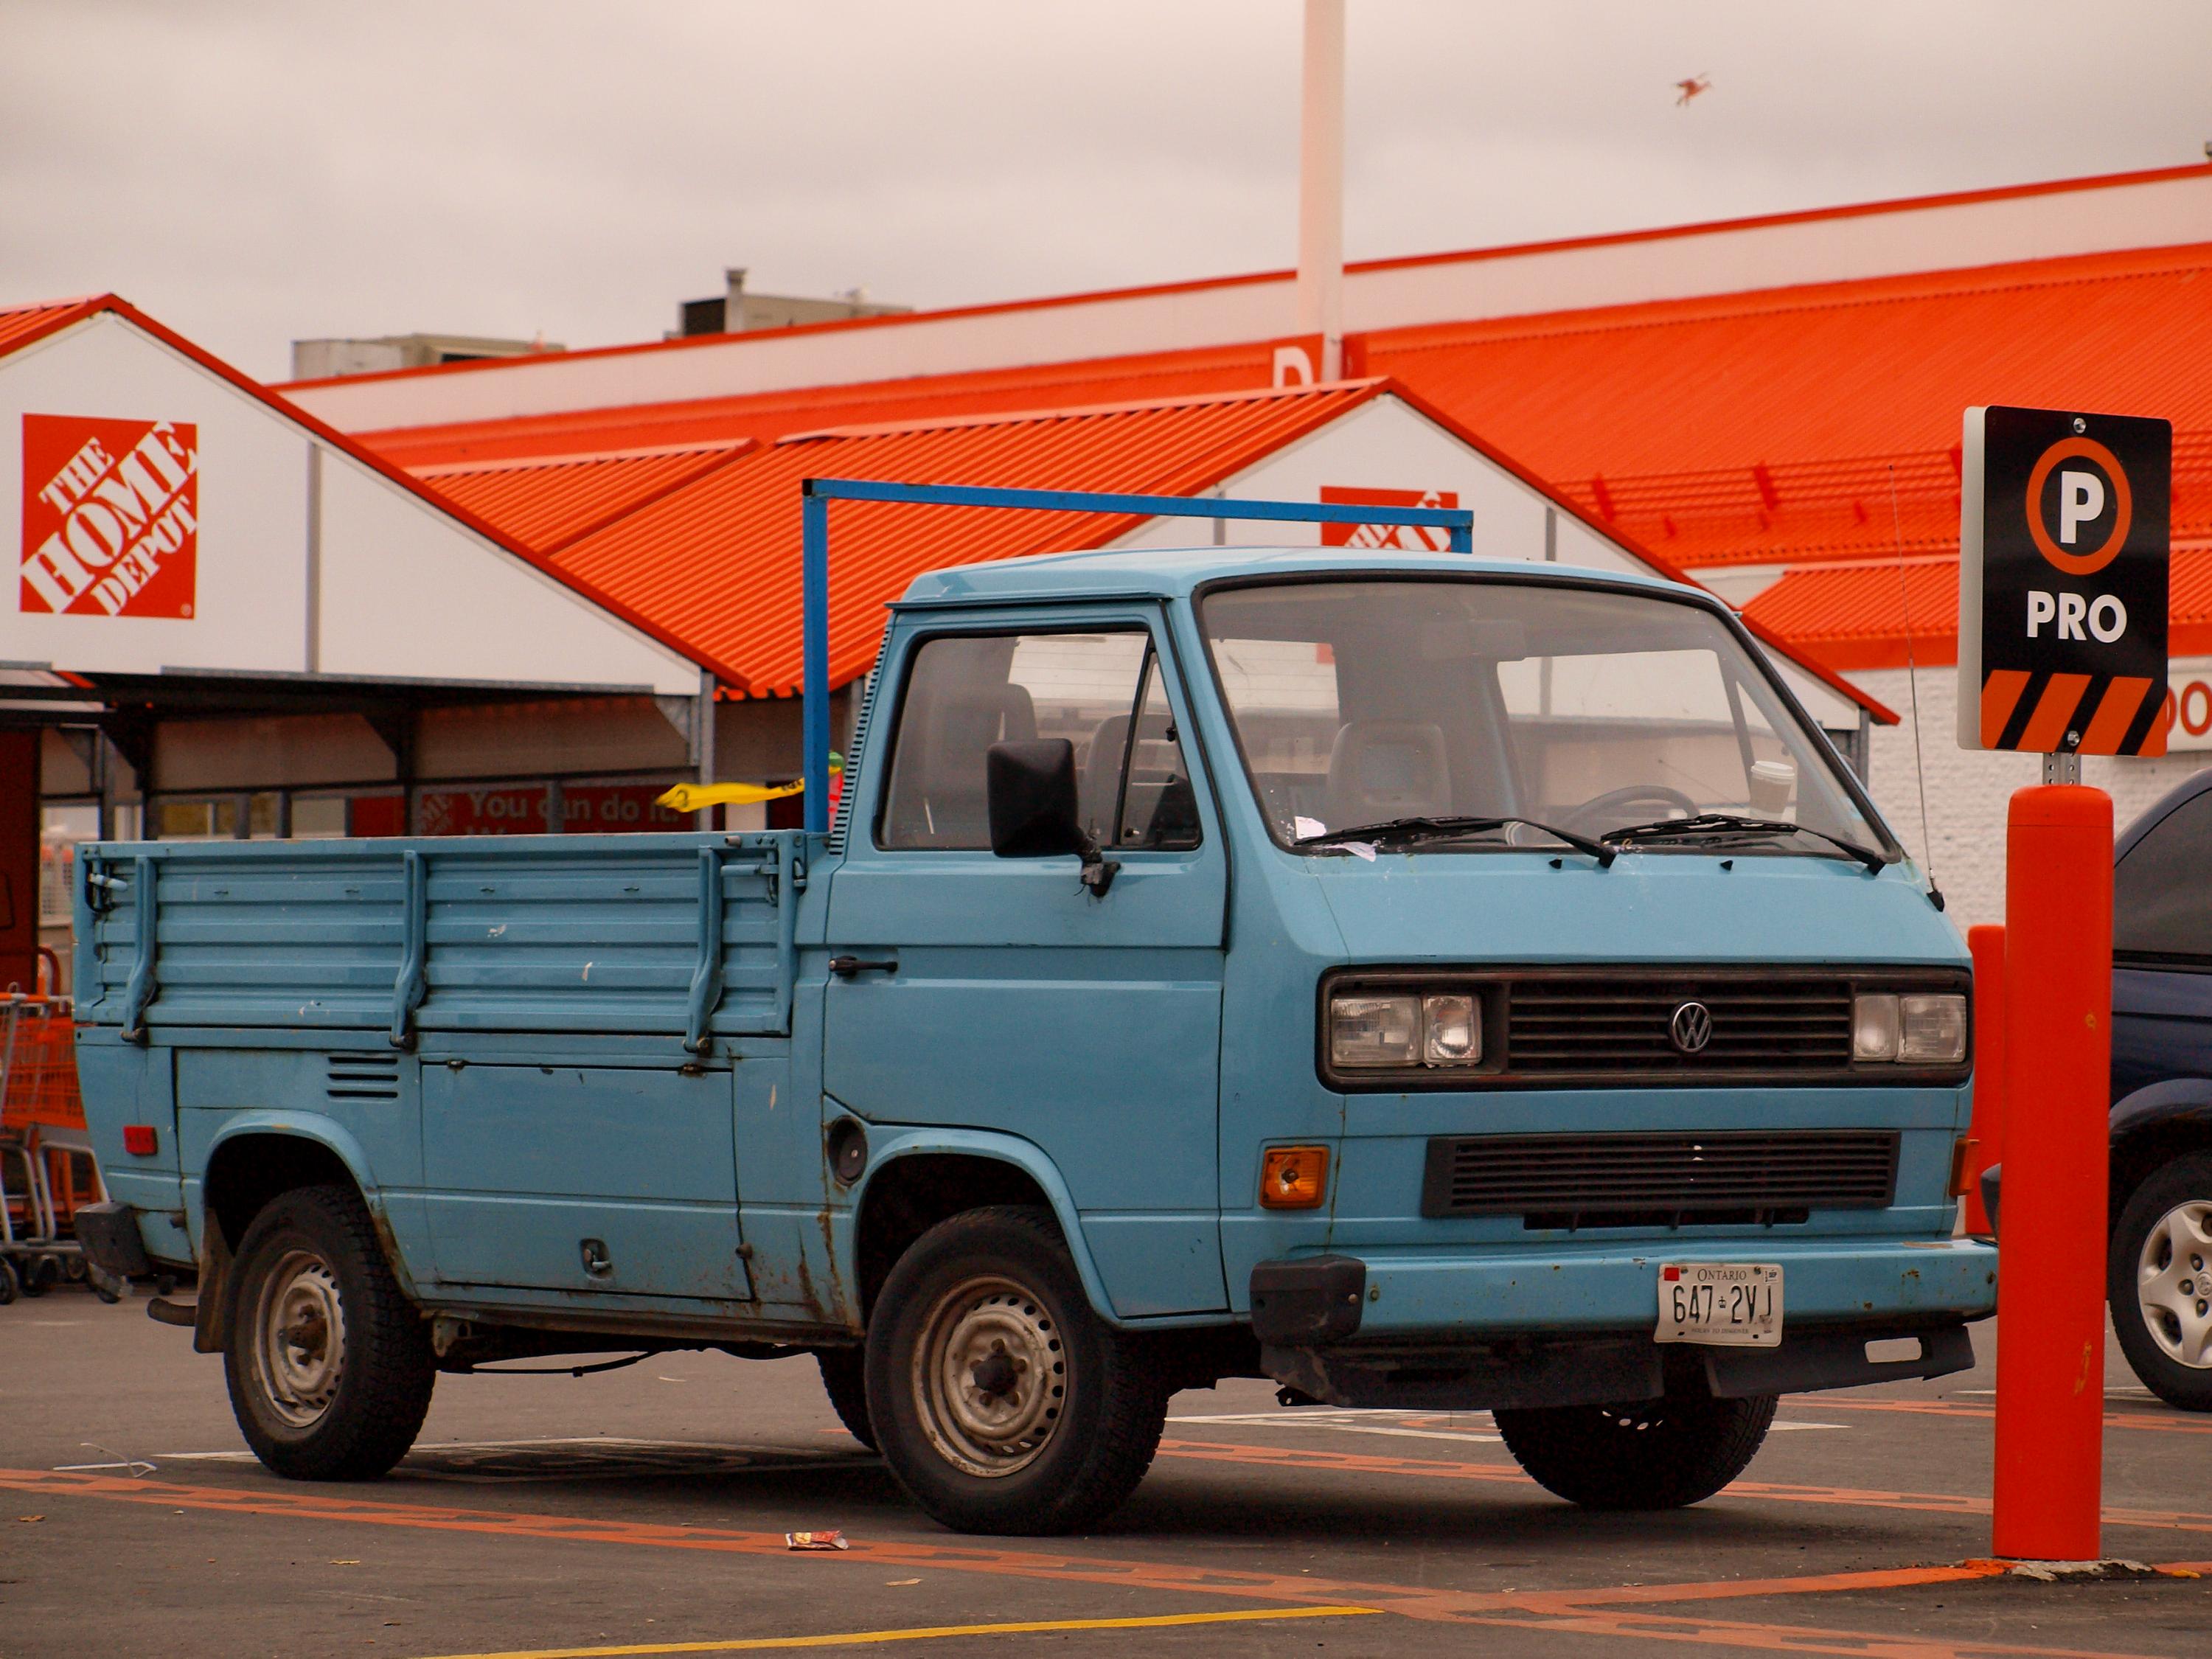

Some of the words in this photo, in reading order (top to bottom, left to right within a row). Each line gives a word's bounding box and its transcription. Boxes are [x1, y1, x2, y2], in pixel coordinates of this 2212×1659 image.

[38, 437, 115, 515] THE
[2059, 470, 2105, 544] P
[21, 420, 198, 613] HOME
[90, 494, 197, 616] DEPOT
[2026, 591, 2128, 643] PRO
[466, 791, 528, 818] You
[600, 793, 640, 822] do
[1672, 1285, 1714, 1324] 647
